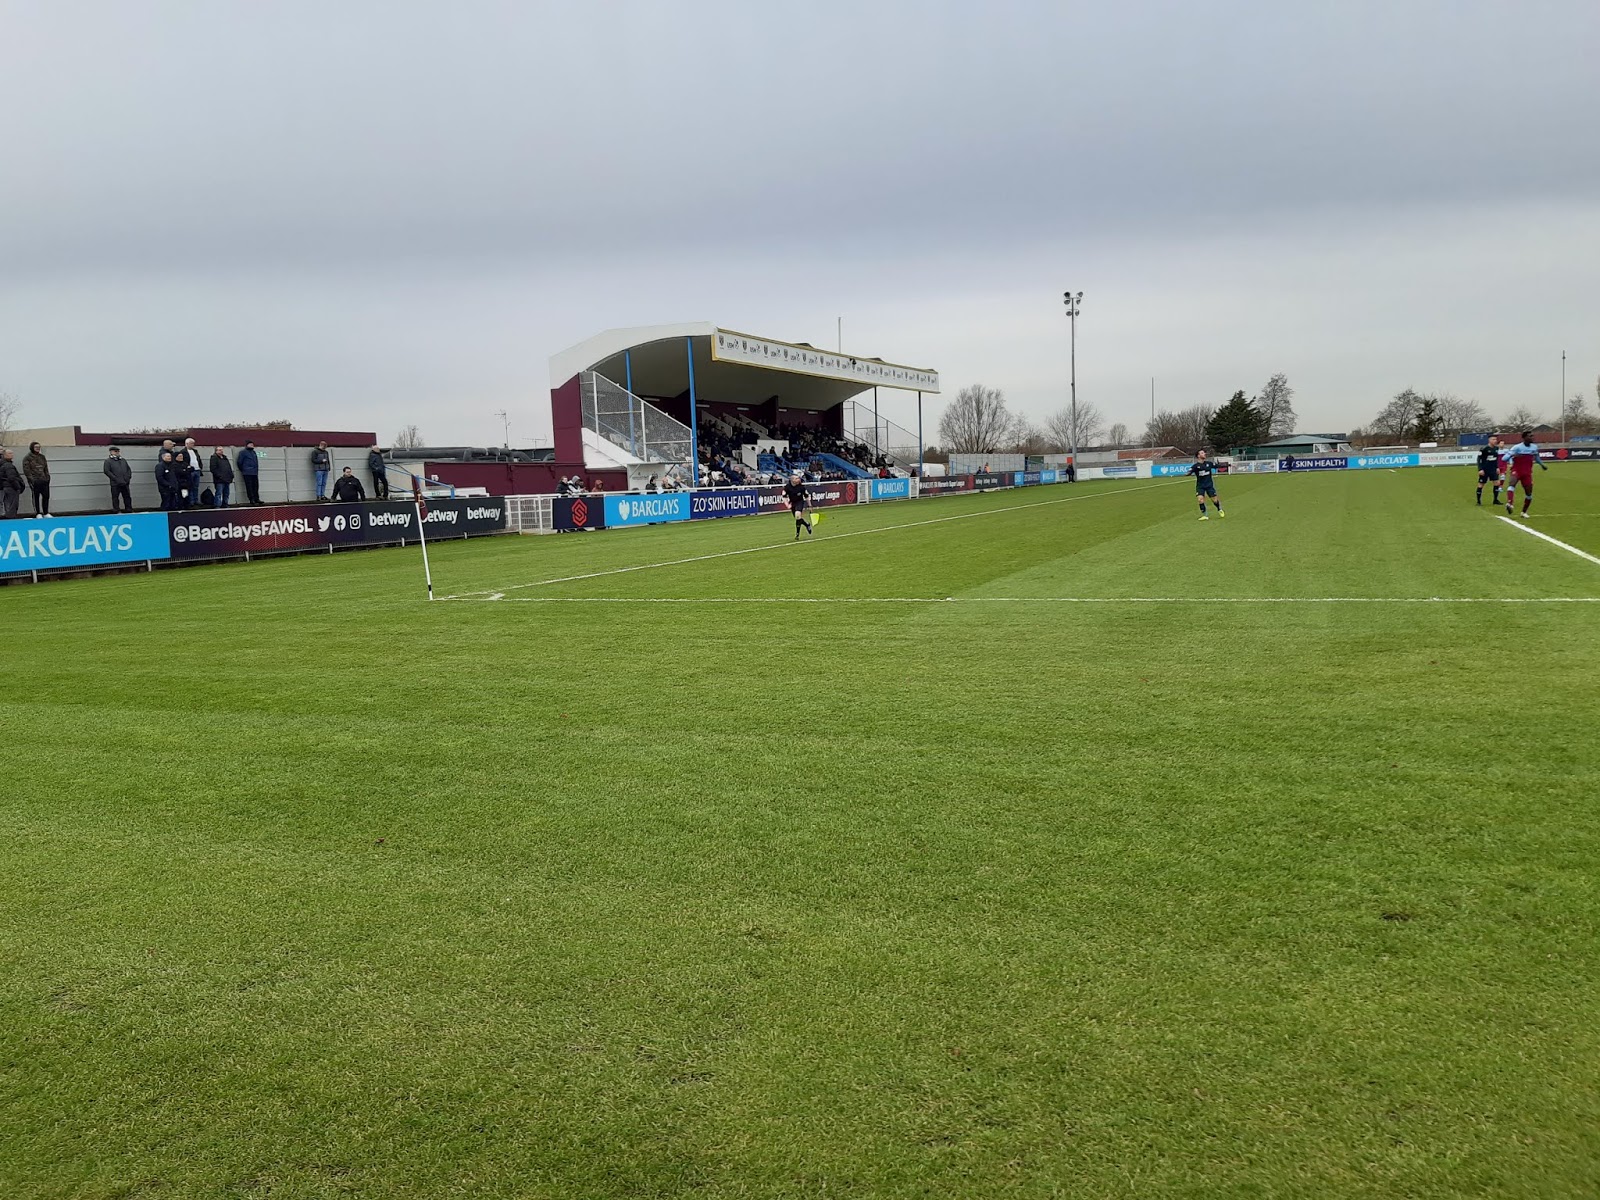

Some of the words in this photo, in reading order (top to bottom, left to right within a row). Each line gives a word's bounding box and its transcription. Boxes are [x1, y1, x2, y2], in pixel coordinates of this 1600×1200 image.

[1314, 459, 1345, 467] HEALTH
[1368, 456, 1409, 464] BARCLAYS
[708, 497, 725, 511] SKIN
[727, 495, 756, 509] HEALTH
[812, 492, 825, 502] Super
[825, 491, 840, 501] League
[632, 498, 679, 517] BARCLAYS
[369, 512, 411, 527] betway
[421, 510, 458, 524] etway
[466, 506, 501, 521] betway
[173, 518, 313, 542] @BarclaysFAWSL
